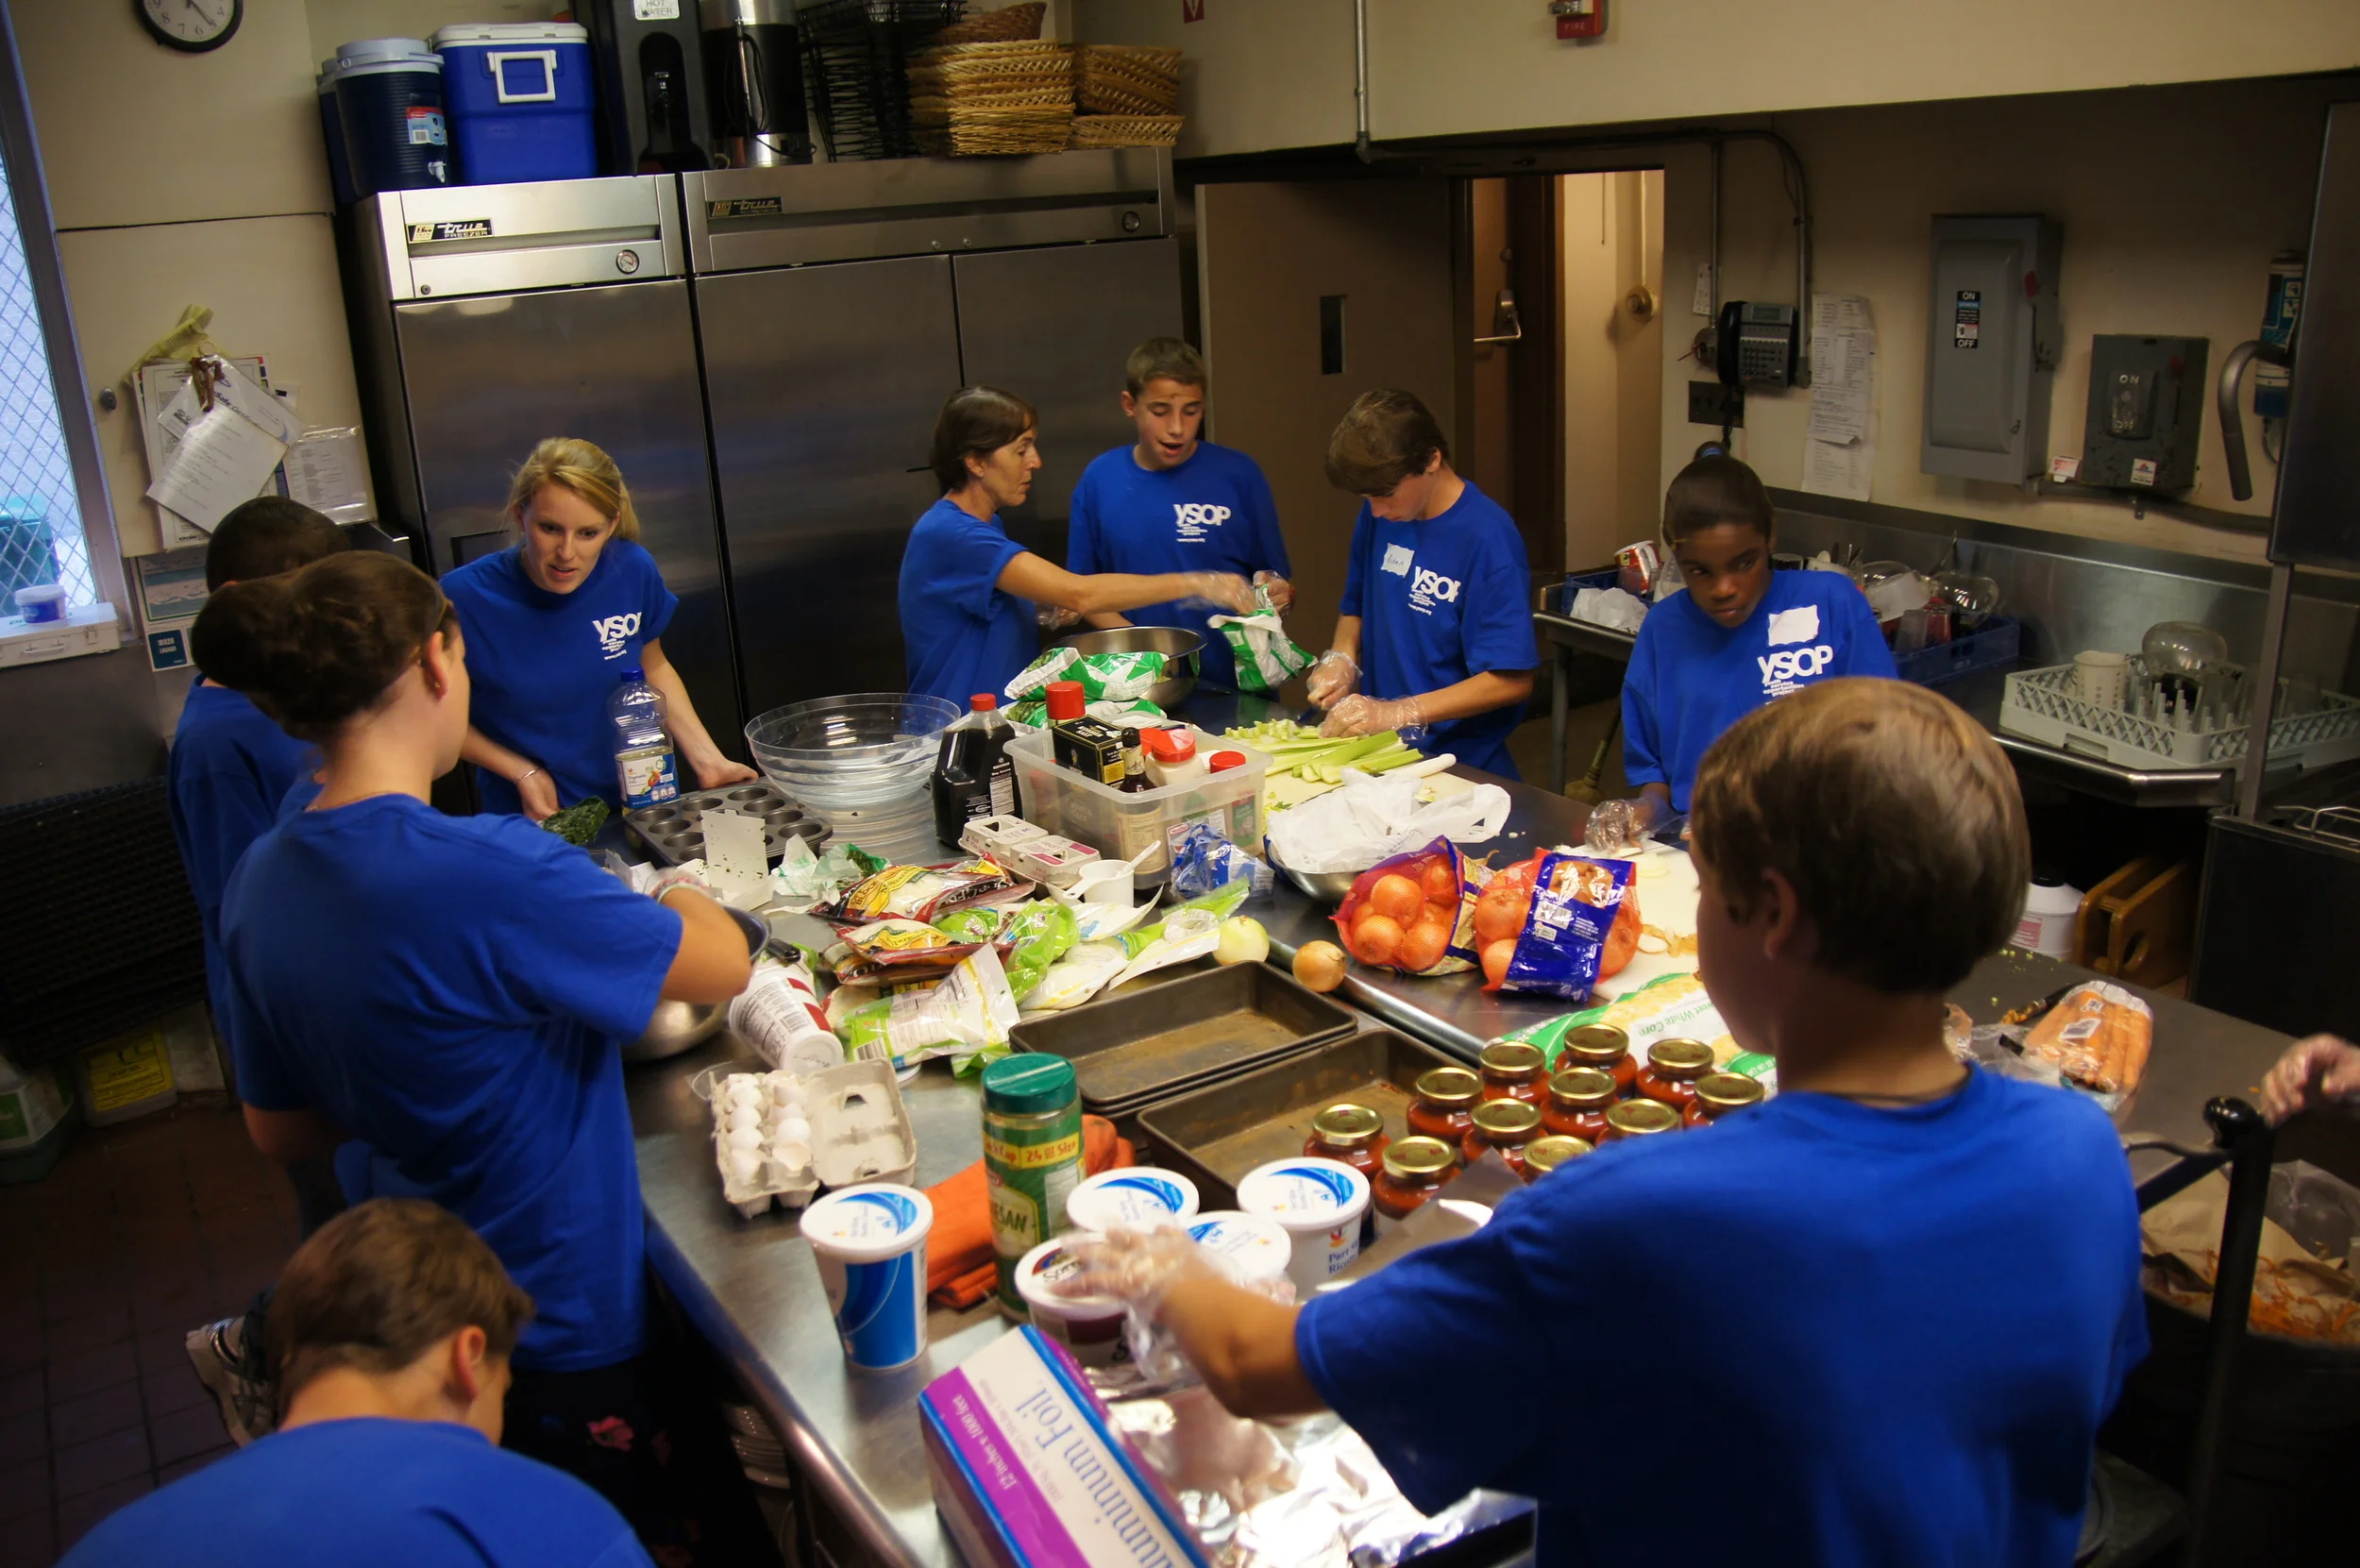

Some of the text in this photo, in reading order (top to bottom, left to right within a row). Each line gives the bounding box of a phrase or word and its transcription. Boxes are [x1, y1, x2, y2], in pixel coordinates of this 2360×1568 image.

[1564, 22, 1587, 31] FIRE
[436, 222, 489, 234] true
[1963, 291, 1976, 300] ON
[1957, 339, 1976, 347] OFF
[2119, 375, 2140, 384] ON
[1666, 1007, 1695, 1028] White
[1639, 1020, 1665, 1037] Corn
[1026, 1150, 1043, 1163] 24
[1057, 1140, 1077, 1155] Size
[1328, 1247, 1349, 1263] Part
[948, 1393, 969, 1416] feet
[960, 1412, 985, 1440] 1000
[980, 1442, 1009, 1477] inches
[1014, 1386, 1174, 1568] uminum Foil
